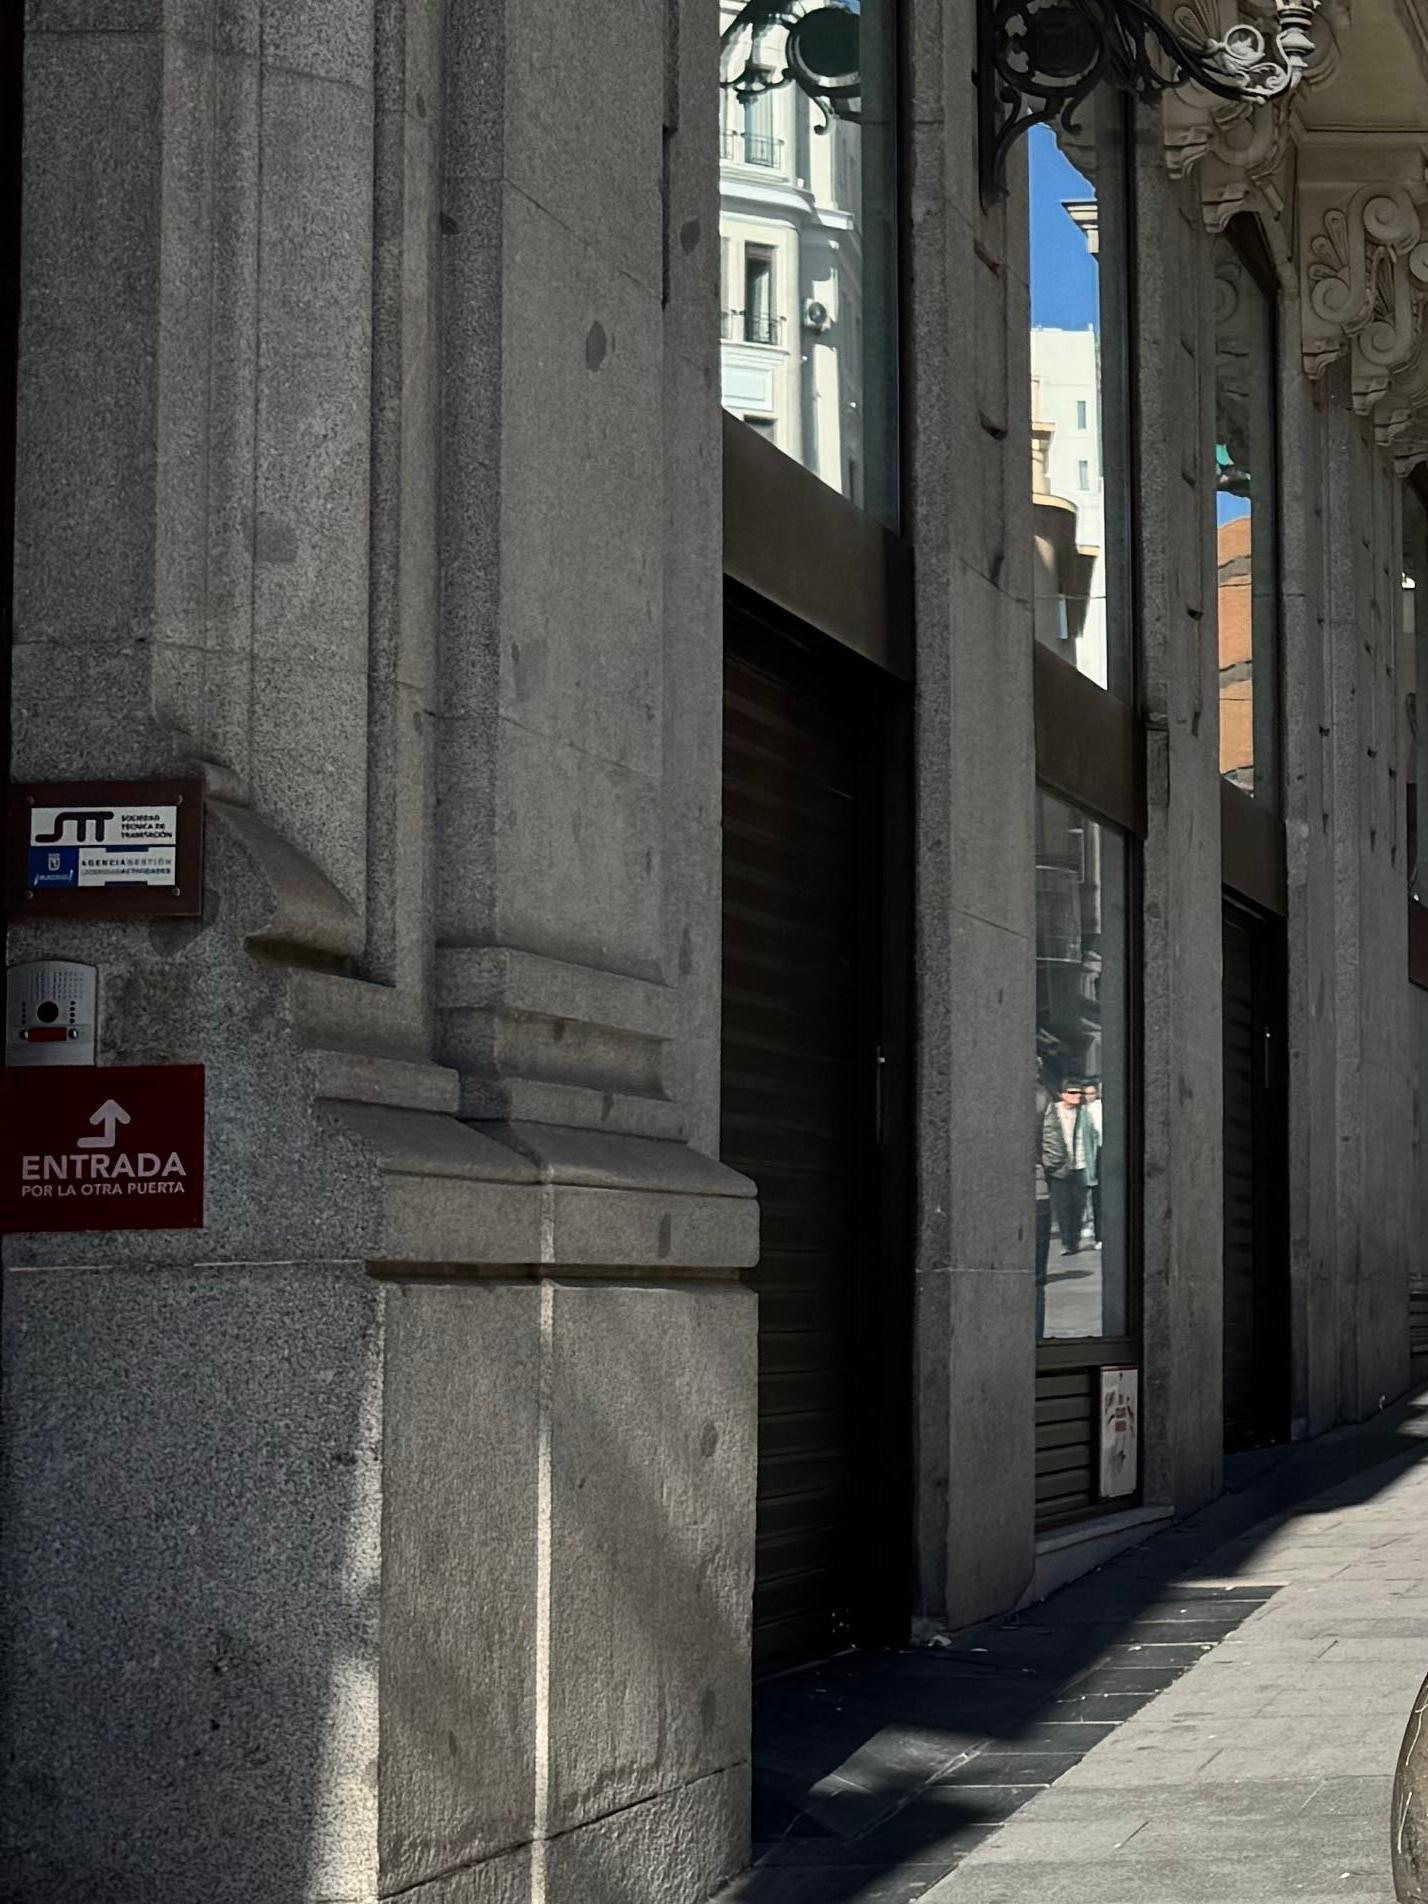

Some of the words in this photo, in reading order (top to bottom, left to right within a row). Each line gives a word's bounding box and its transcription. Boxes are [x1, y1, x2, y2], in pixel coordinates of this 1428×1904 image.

[22, 1151, 187, 1180] ENTRADA
[22, 1184, 53, 1197] POR
[57, 1184, 77, 1196] LA
[81, 1183, 122, 1196] OTRA
[128, 1181, 185, 1195] PUERTA
